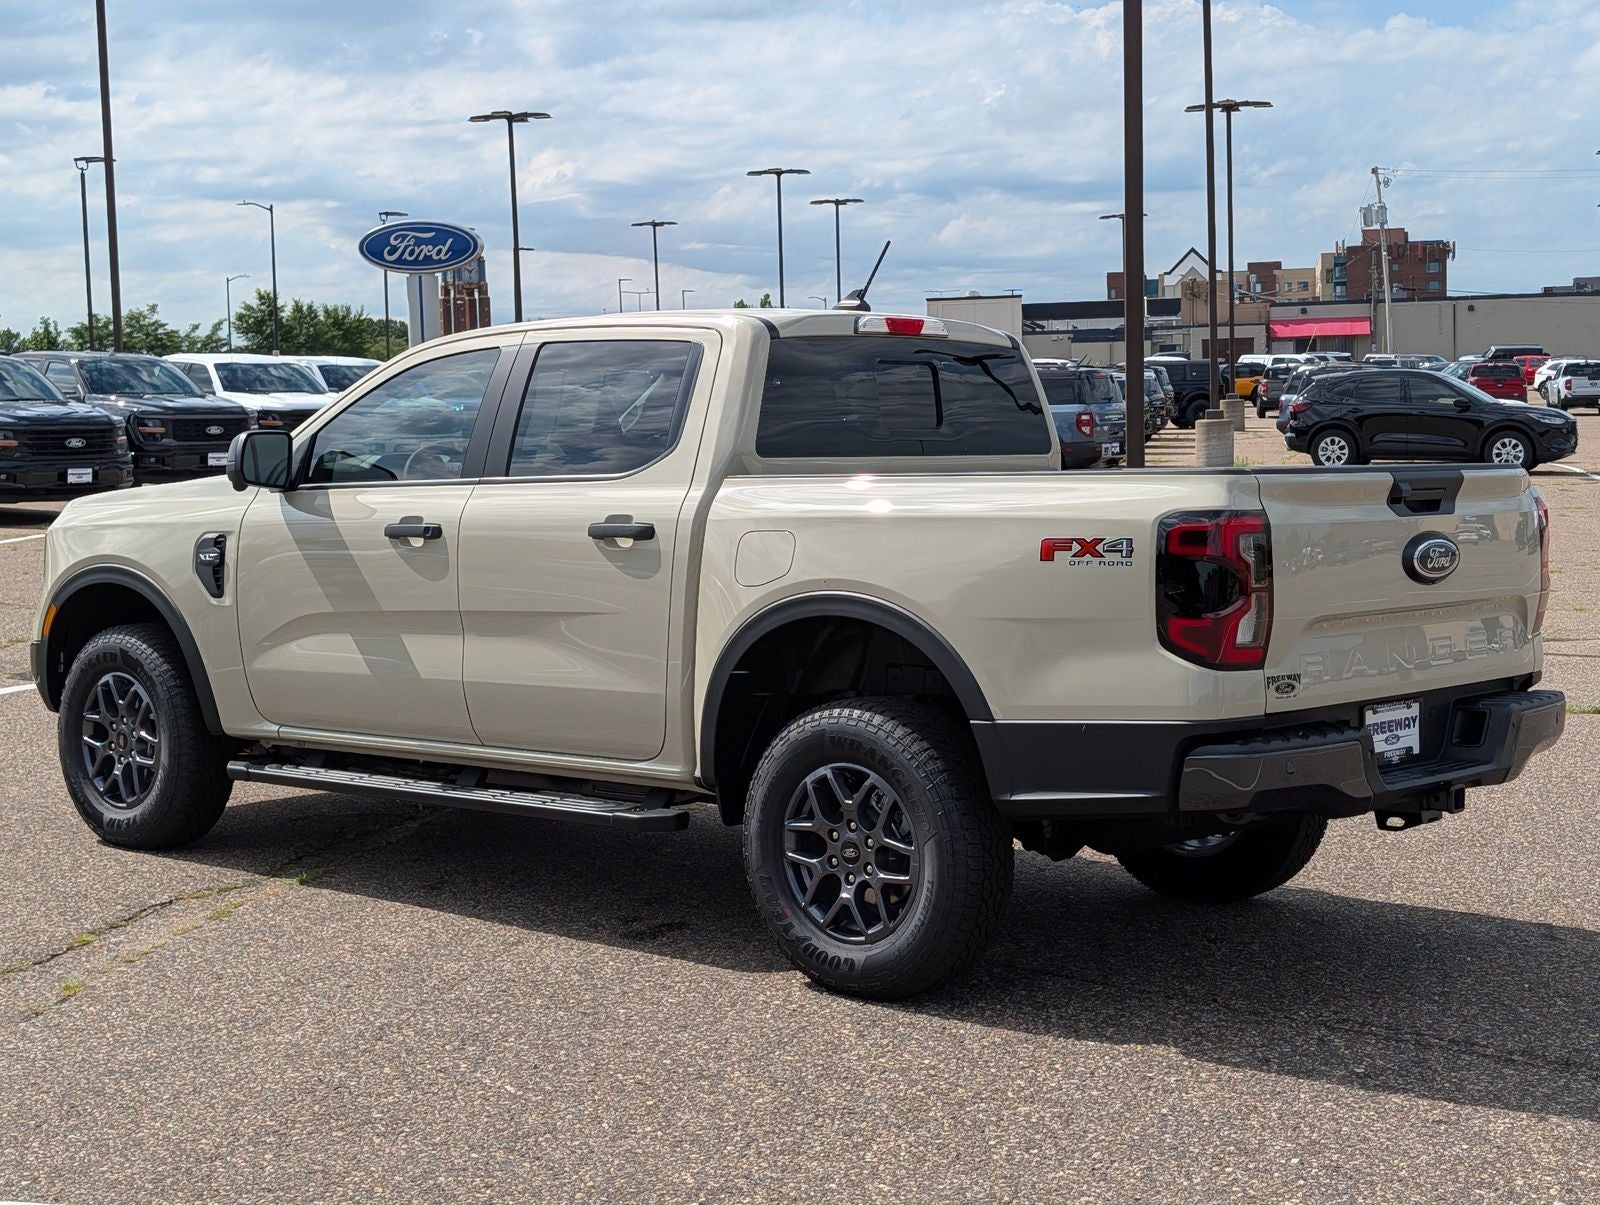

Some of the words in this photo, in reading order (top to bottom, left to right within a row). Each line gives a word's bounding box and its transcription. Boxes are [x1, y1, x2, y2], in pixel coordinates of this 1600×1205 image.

[383, 231, 453, 261] Ford
[1040, 537, 1133, 561] FX4
[1427, 547, 1452, 569] Ford
[1300, 621, 1520, 682] RANGER
[1266, 673, 1301, 690] FREEWAY
[1366, 715, 1418, 736] FREEWAY
